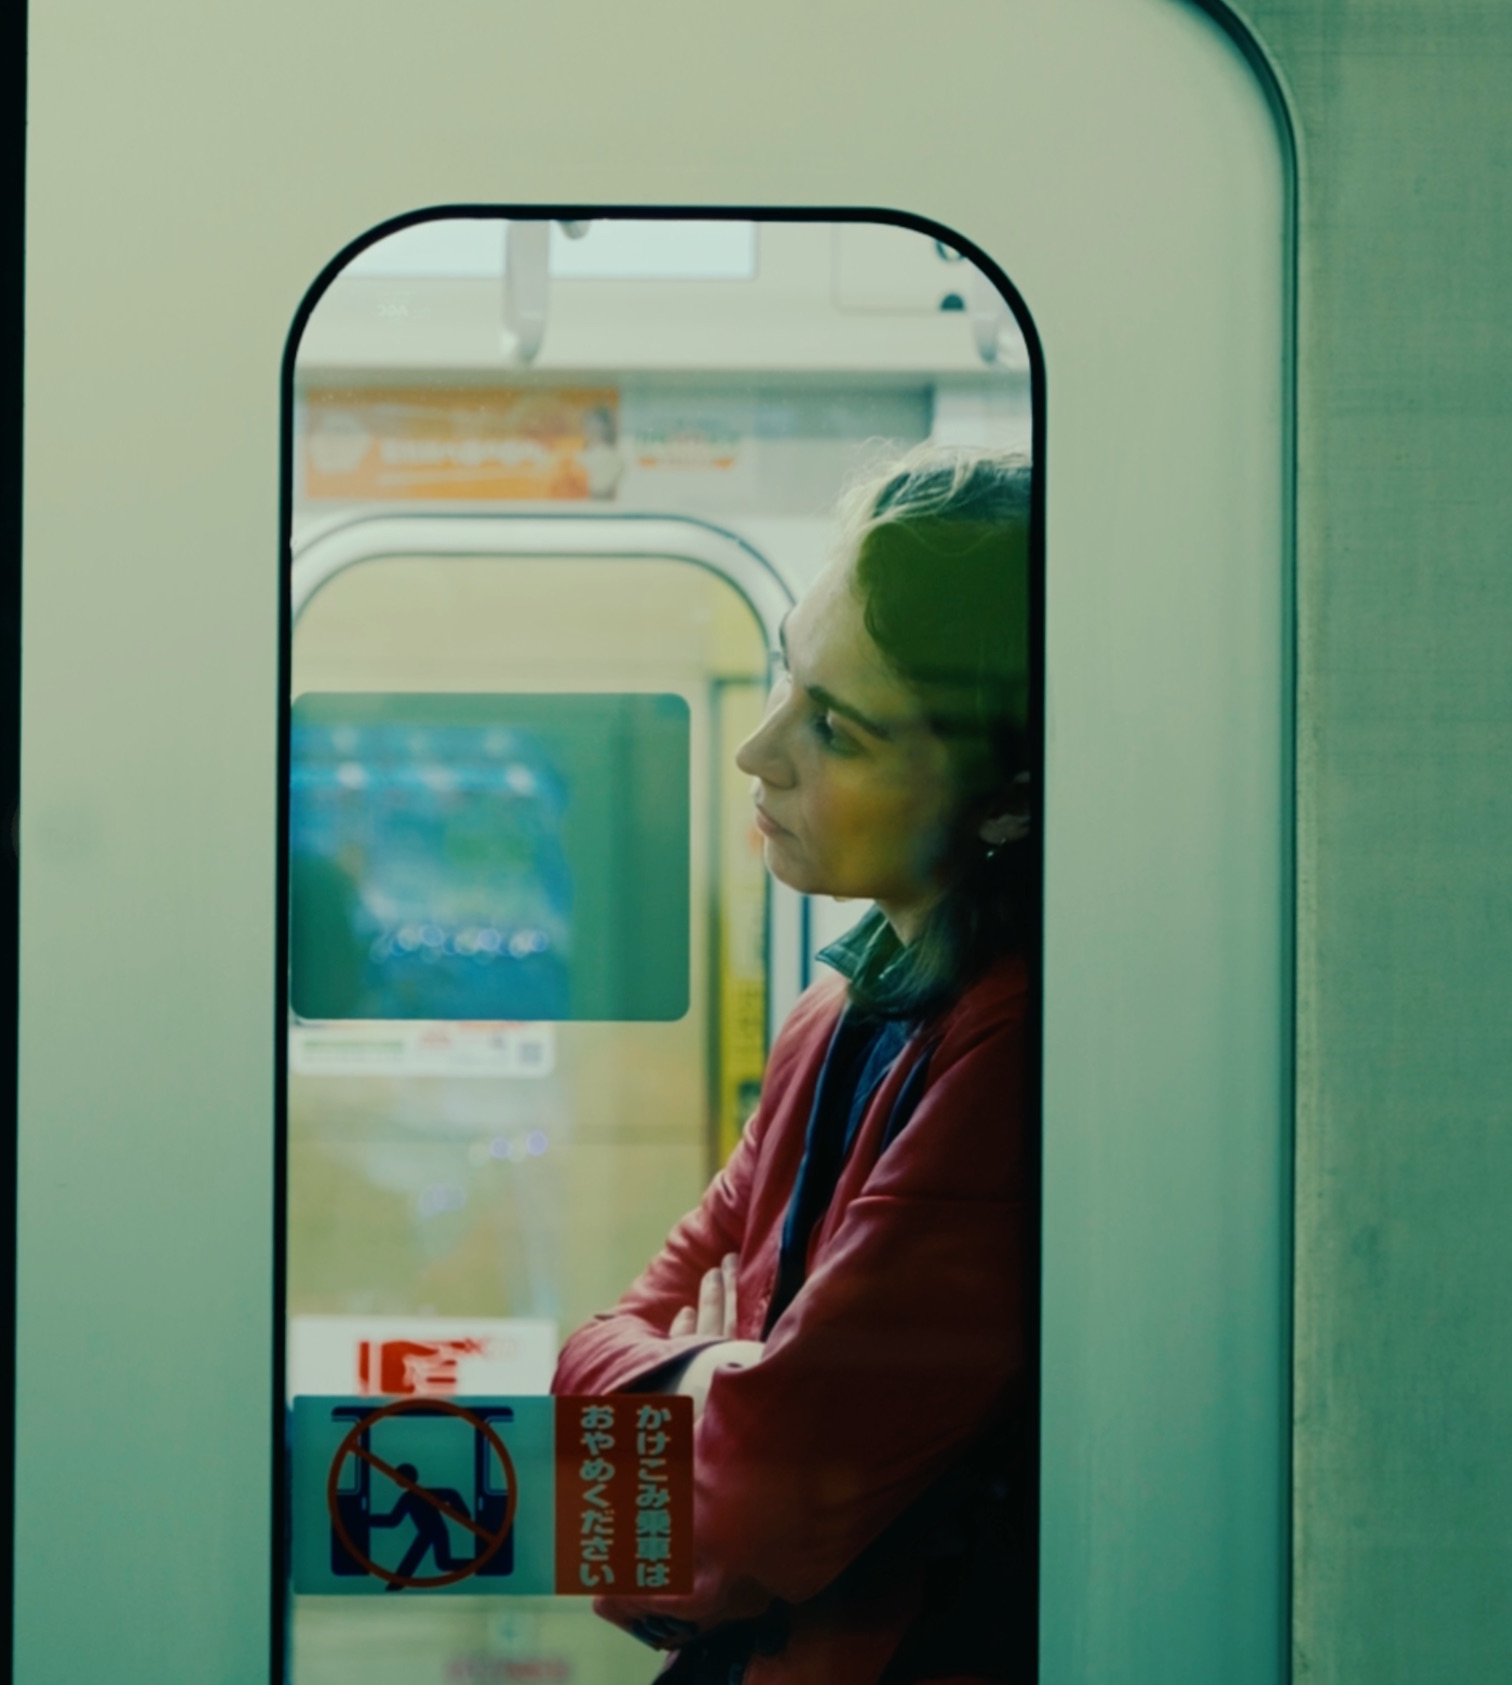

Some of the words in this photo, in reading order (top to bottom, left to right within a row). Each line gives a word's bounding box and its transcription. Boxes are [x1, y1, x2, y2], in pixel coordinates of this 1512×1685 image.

[579, 1405, 615, 1587] おやめください
[635, 1405, 671, 1587] かけこみ乗車は
